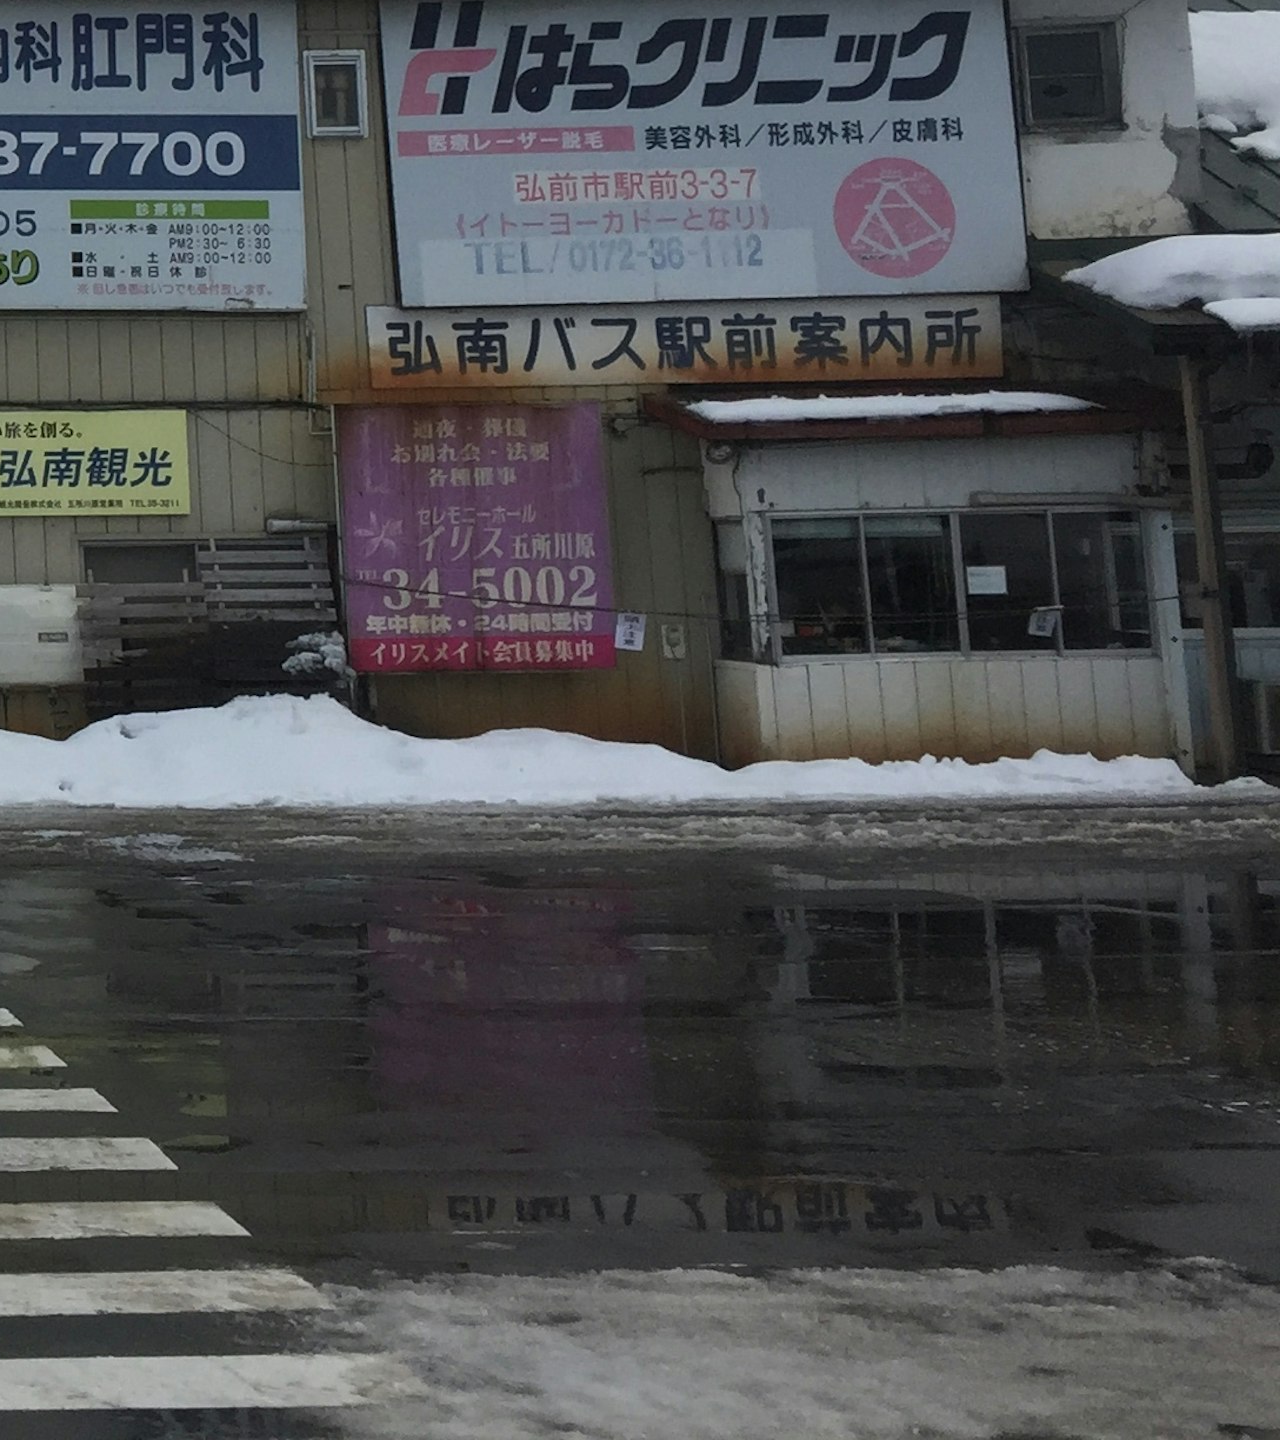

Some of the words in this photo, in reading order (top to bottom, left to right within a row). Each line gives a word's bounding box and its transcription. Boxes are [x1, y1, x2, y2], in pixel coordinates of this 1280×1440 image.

[490, 11, 972, 114] はらクリニック
[426, 128, 604, 153] 医療レーザー脱毛
[515, 168, 759, 203] 弘前市駅前3-3-7
[135, 202, 206, 217] 診療時間
[384, 307, 981, 376] 弘南バス駅前案内所
[428, 466, 518, 488] 各種催事
[416, 505, 538, 527] セレモニーホール
[418, 525, 505, 562] イリス
[510, 532, 596, 560] 五所川原
[381, 565, 598, 610] 34-5002
[365, 612, 594, 634] 年中無休・24時間受付
[370, 639, 595, 665] イリスメイト会員募集中
